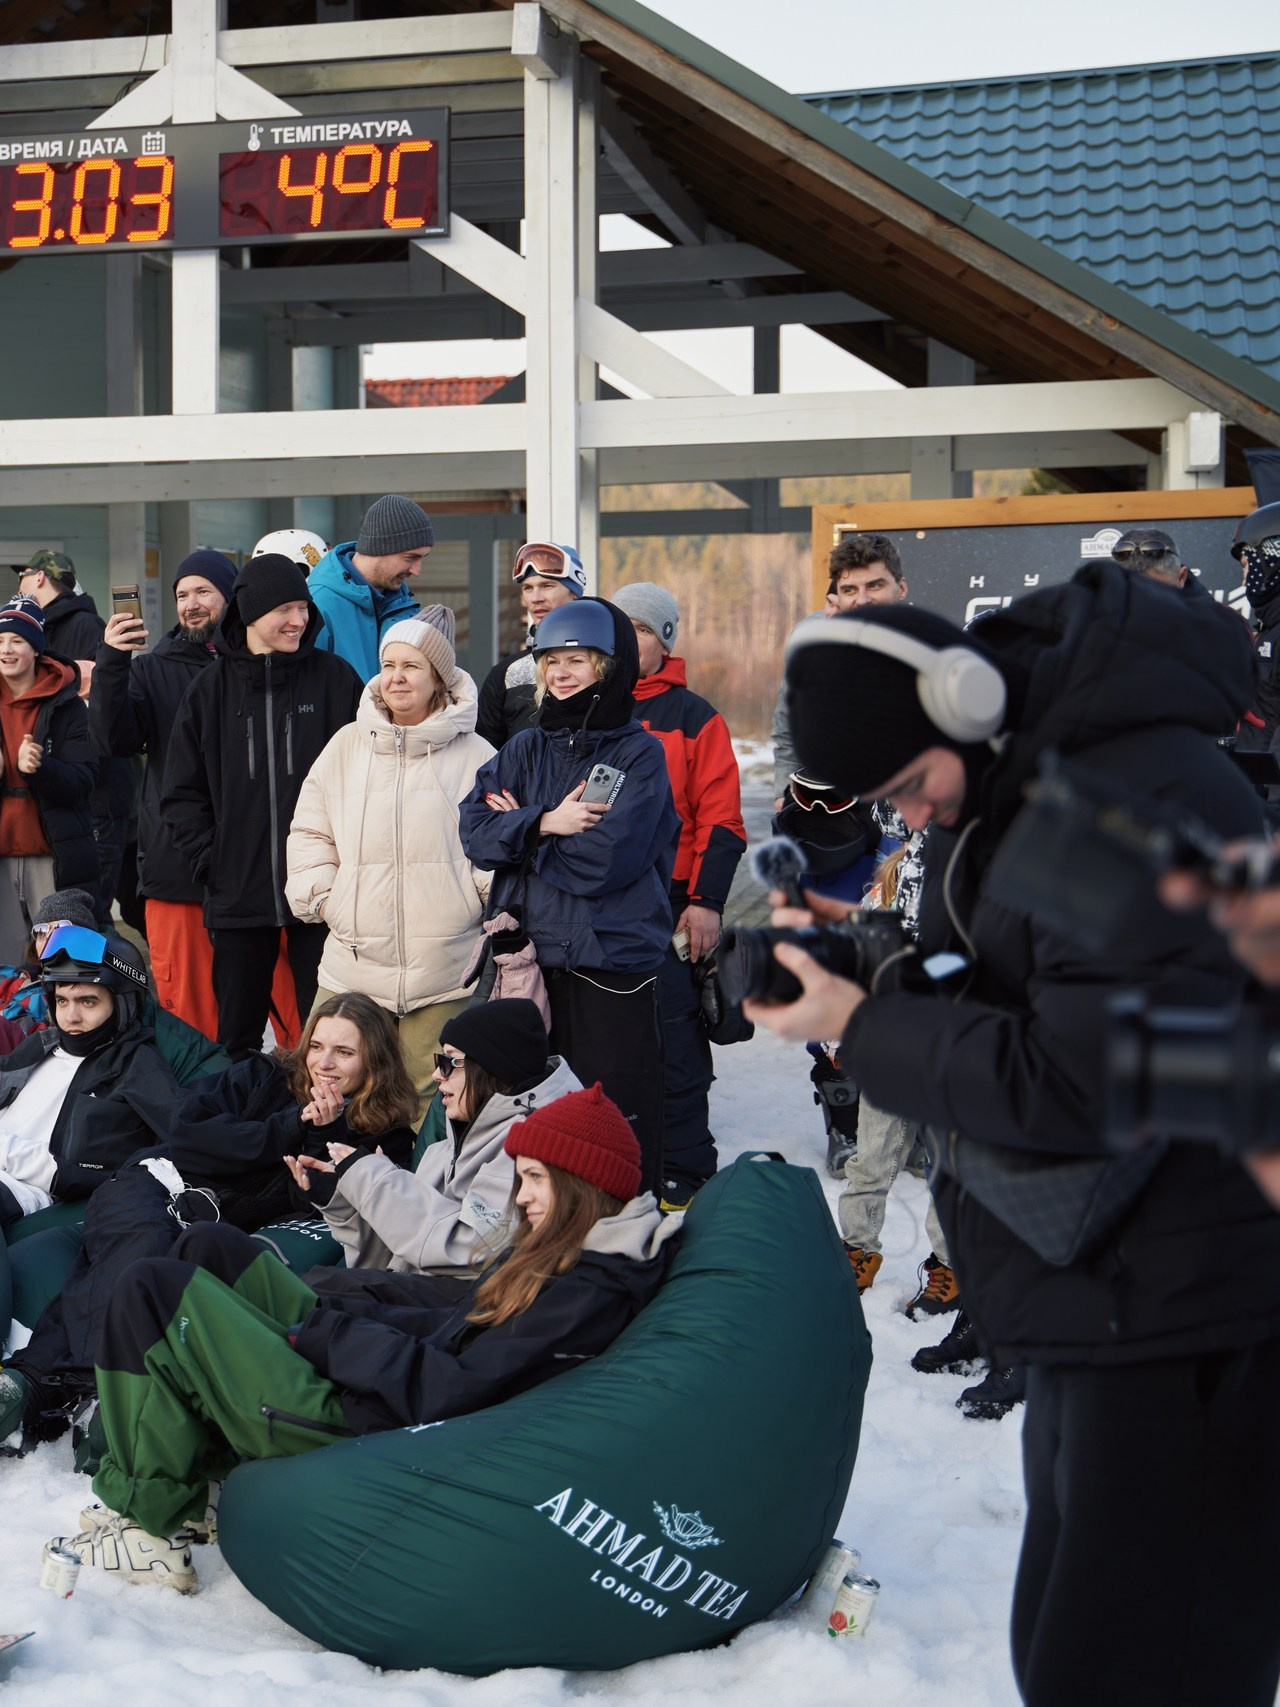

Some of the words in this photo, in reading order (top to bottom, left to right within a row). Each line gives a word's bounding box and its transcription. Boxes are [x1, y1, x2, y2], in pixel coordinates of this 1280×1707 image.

[270, 120, 413, 144] ТЕМПЕРАТУРА
[67, 140, 75, 156] /
[77, 137, 128, 158] ДАТА
[8, 156, 175, 247] 3.03
[112, 956, 147, 984] WHITELAB
[78, 1162, 104, 1170] TERROR
[533, 1487, 693, 1592] AHMAD
[683, 1569, 750, 1620] TEA
[590, 1568, 669, 1618] LONDON
